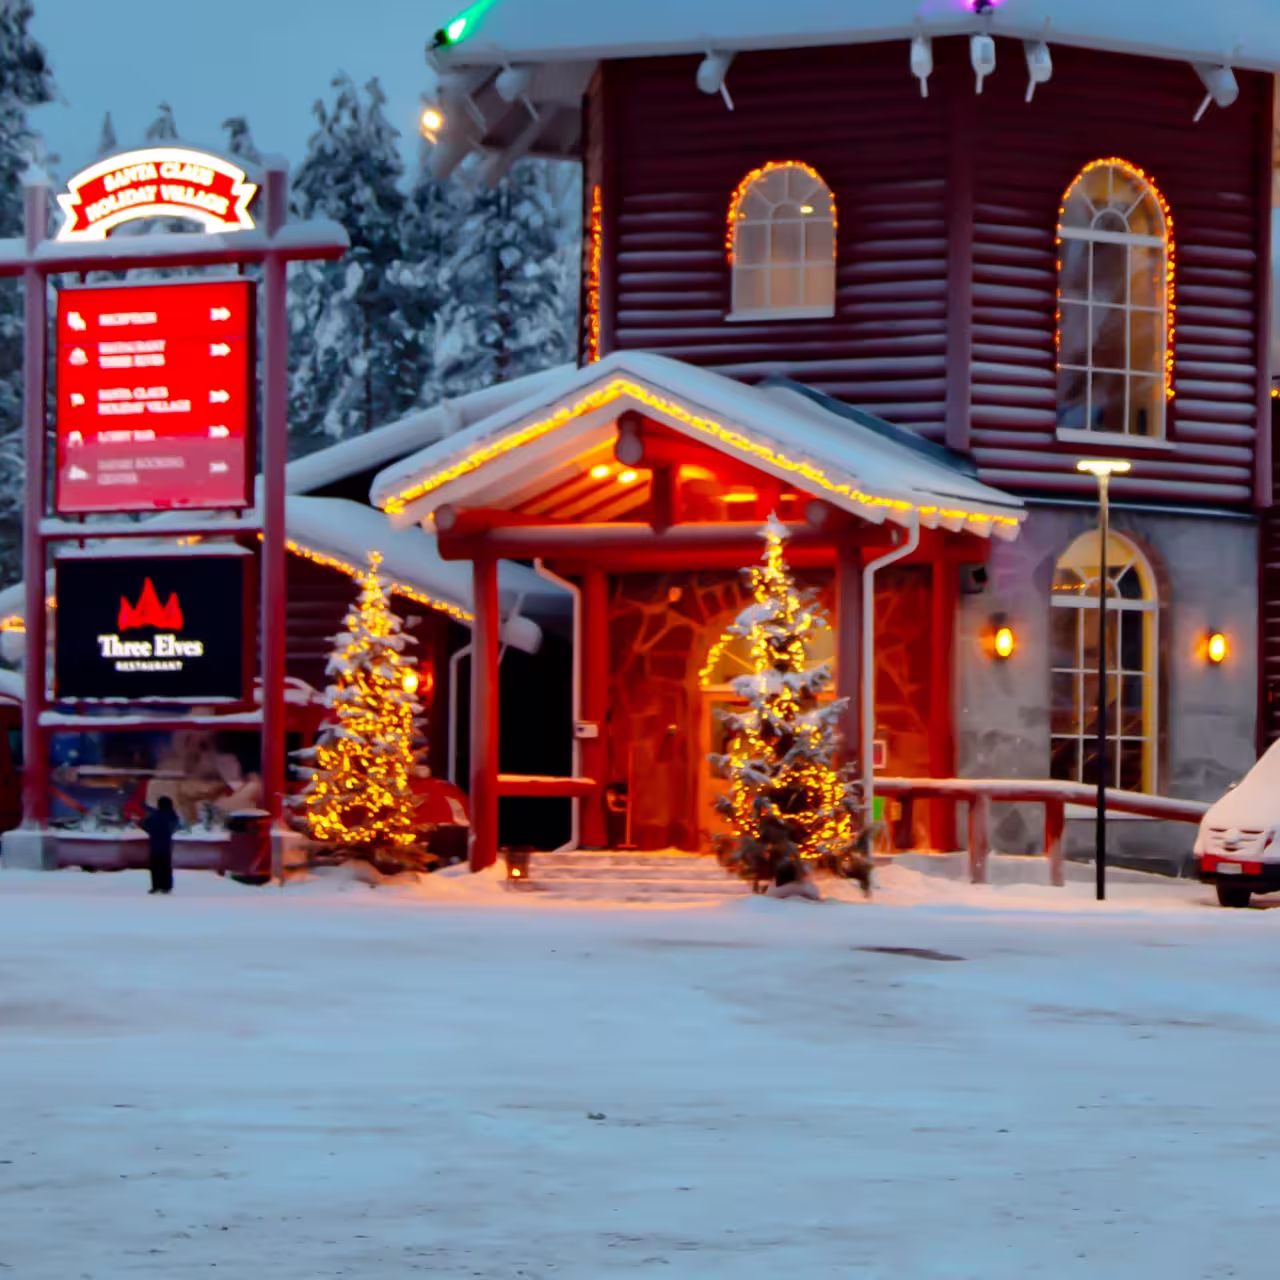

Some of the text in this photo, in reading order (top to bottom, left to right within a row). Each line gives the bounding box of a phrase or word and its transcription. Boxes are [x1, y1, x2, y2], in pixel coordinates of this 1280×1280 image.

[103, 161, 214, 192] SANTA CLAUS
[85, 184, 229, 223] HOLIDAY VILLAGE
[97, 634, 204, 658] Three Elves
[115, 661, 183, 671] RESTAURANT
